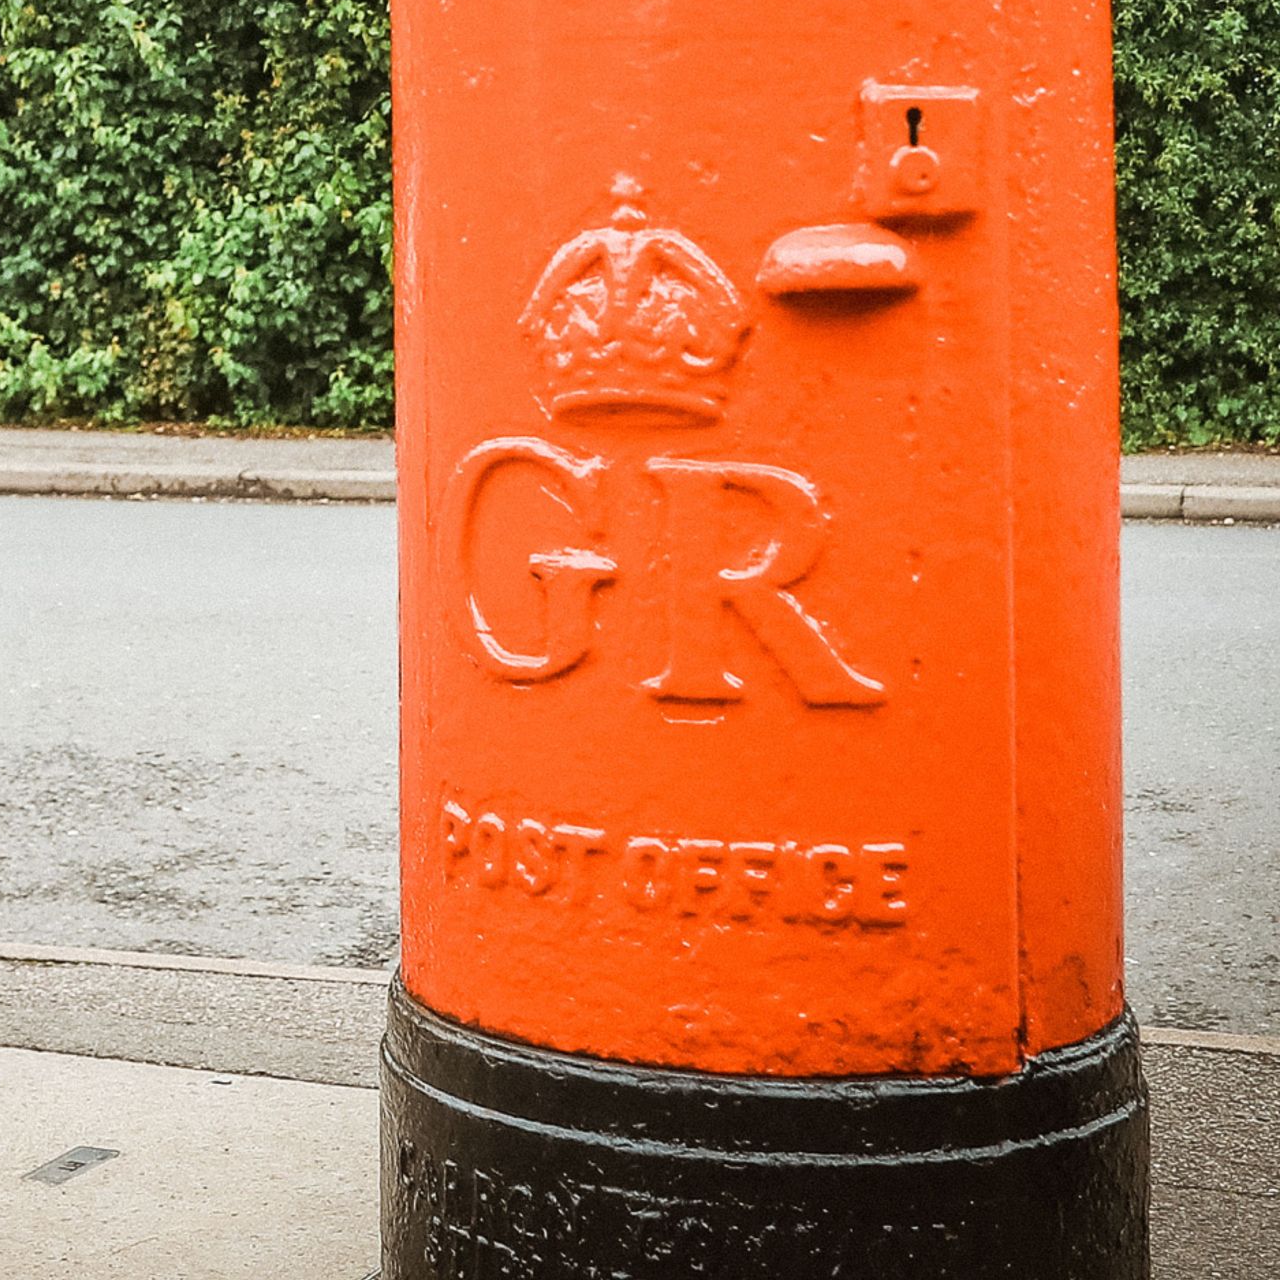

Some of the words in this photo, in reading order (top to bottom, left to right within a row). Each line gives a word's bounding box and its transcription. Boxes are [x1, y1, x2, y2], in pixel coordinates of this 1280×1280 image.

[440, 434, 888, 712] GR
[441, 800, 608, 902] POST
[625, 836, 907, 929] OFFICE
